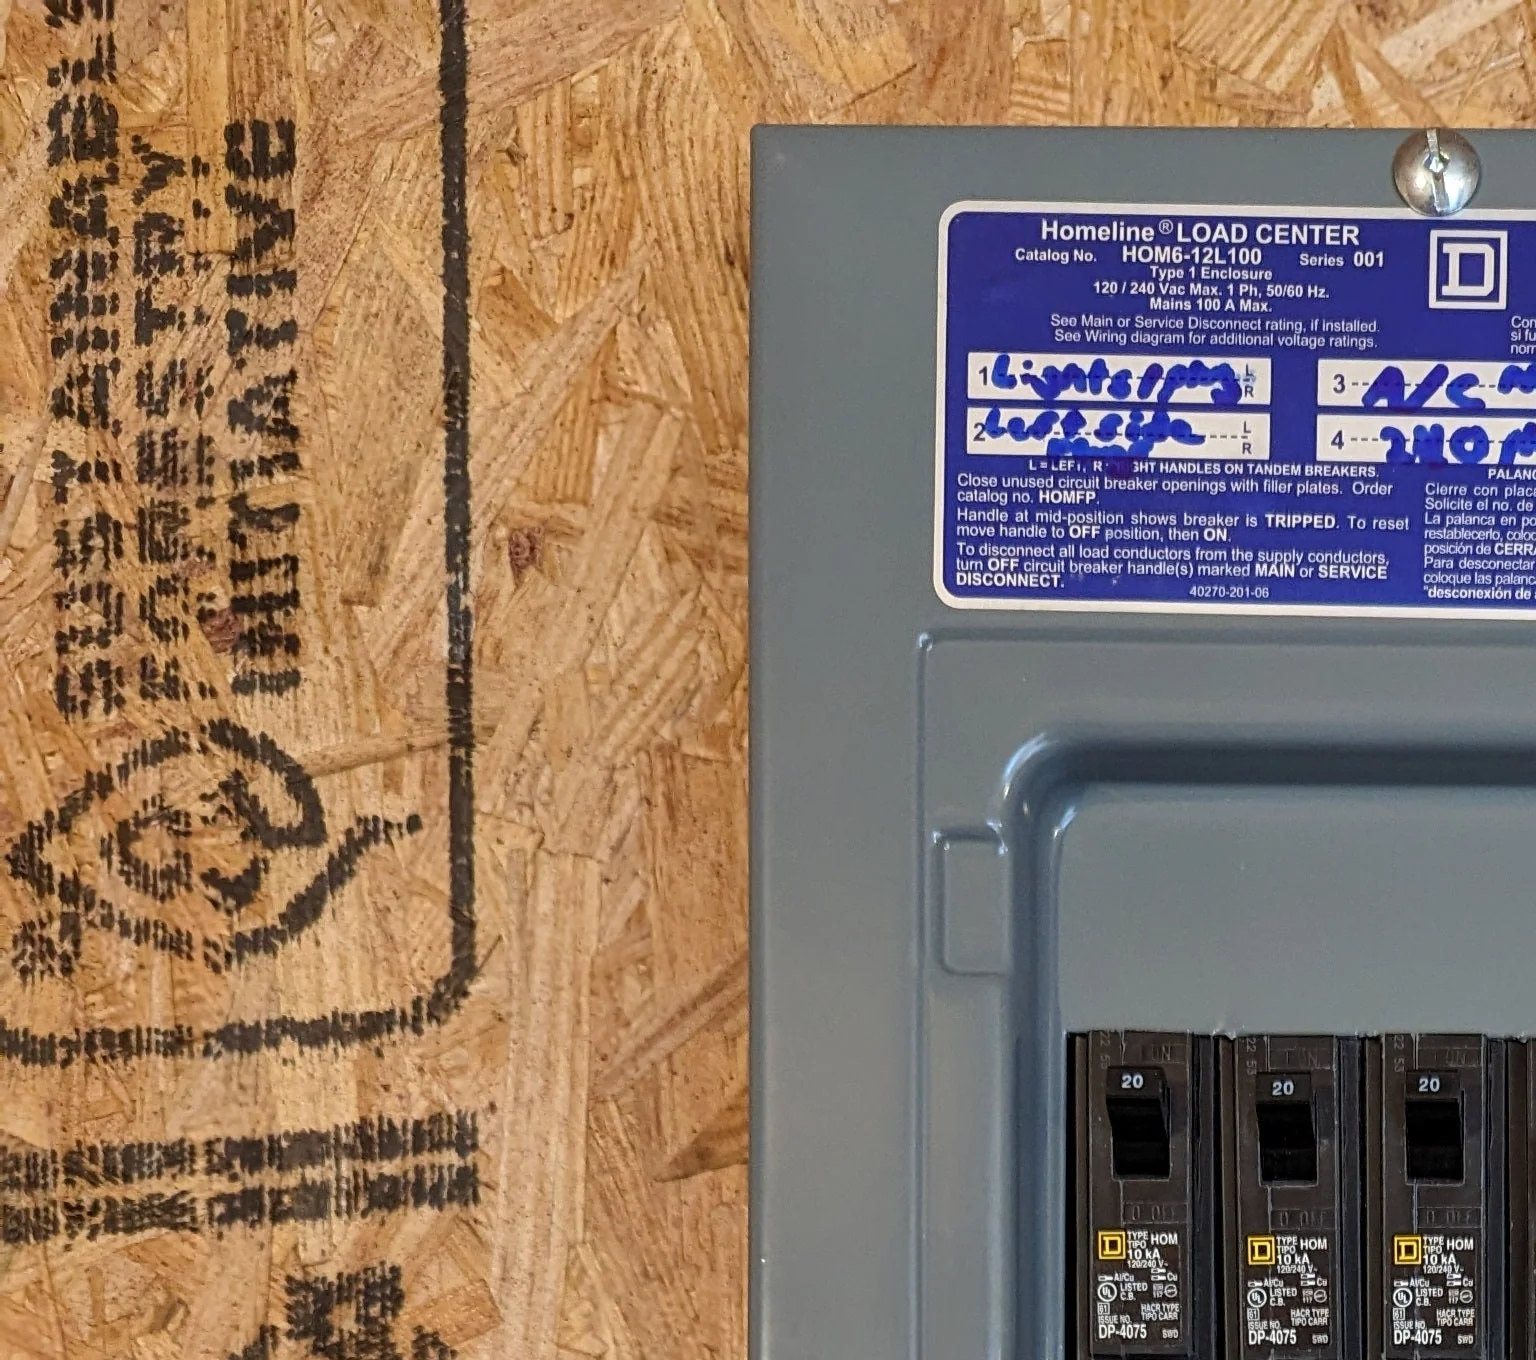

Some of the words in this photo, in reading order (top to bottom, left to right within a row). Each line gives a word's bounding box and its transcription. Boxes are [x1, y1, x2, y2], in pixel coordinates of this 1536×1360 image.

[1176, 222, 1247, 243] LOAD
[1255, 223, 1359, 245] CENTER
[1014, 247, 1070, 264] Catalog
[1072, 248, 1097, 261] No.
[1121, 246, 1262, 265] HOM6-12L100
[1299, 253, 1344, 266] Series
[1353, 251, 1383, 267] 001
[1149, 265, 1184, 284] Type
[1200, 266, 1273, 282] Enclosure
[1094, 280, 1118, 294] 120
[1130, 281, 1155, 296] 240
[1158, 282, 1185, 297] Vac
[1189, 282, 1221, 297] Max.
[1239, 283, 1261, 302] Ph,
[1266, 284, 1303, 297] 50/60
[1307, 284, 1328, 298] Hz.
[1149, 297, 1192, 310] Mains
[1196, 297, 1220, 311] 100
[1224, 298, 1235, 311] A
[1239, 298, 1272, 312] Max.
[1050, 313, 1077, 328] See
[1080, 313, 1113, 328] Main
[1116, 317, 1131, 327] or
[1134, 315, 1184, 331] Service
[1187, 316, 1262, 332] Disconnect
[1264, 318, 1306, 336] rating,
[1310, 318, 1319, 331] if
[1321, 319, 1380, 335] installed.
[979, 366, 987, 386] 1
[1333, 374, 1345, 393] 3
[224, 119, 300, 696] INITIATIVE
[134, 132, 212, 702] FORESTRY
[973, 423, 986, 442] 2
[1330, 430, 1344, 450] 4
[956, 488, 1008, 505] catalog
[1011, 492, 1034, 503] no.
[1038, 489, 1100, 504] HOMFP.
[1188, 585, 1270, 598] 40270-201-06
[1121, 1074, 1144, 1090] 20
[1271, 1081, 1294, 1096] 20
[1418, 1077, 1440, 1093] 20
[1127, 1231, 1148, 1240] TYPE
[1151, 1233, 1178, 1245] HOM
[1300, 1238, 1328, 1250] HOM
[1446, 1238, 1474, 1250] HOM
[1127, 1249, 1140, 1260] 10
[1144, 1249, 1161, 1260] kA
[1120, 1282, 1148, 1292] LISTED
[1098, 1324, 1147, 1340] DP-4075
[1248, 1330, 1297, 1345] DP-4075
[1393, 1329, 1442, 1345] DP-4075
